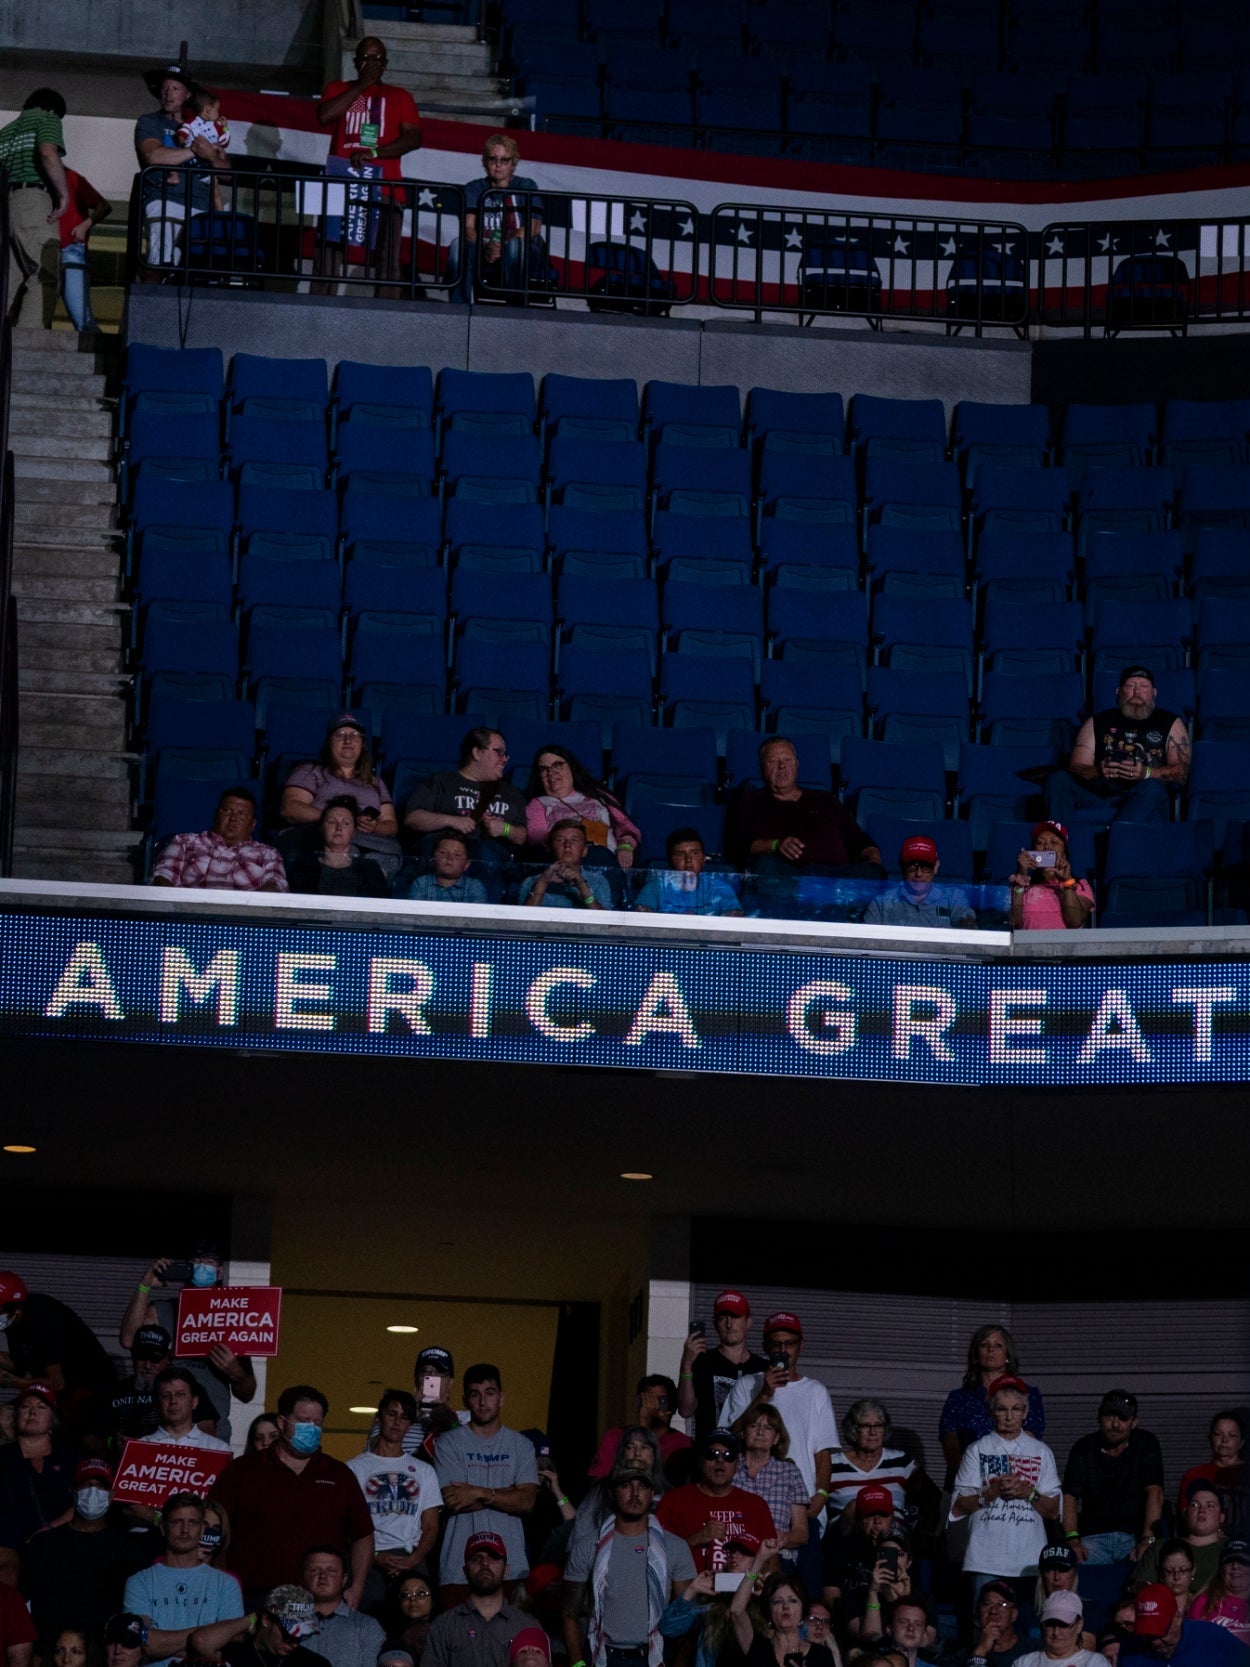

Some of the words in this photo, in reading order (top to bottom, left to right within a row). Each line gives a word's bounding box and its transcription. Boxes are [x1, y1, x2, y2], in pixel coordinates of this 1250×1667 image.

[361, 166, 374, 202] AGIN
[454, 795, 510, 816] TRMP
[44, 941, 703, 1048] AMERICA
[786, 980, 1155, 1064] GREAT
[209, 1298, 249, 1309] MAKE
[182, 1311, 275, 1328] AMERICA
[181, 1331, 226, 1343] GREAT
[228, 1331, 274, 1343] AGAIN
[155, 1453, 198, 1468] MAKE
[122, 1463, 217, 1487] AMERICA
[118, 1480, 167, 1495] GREAT
[1042, 1546, 1070, 1560] USAF
